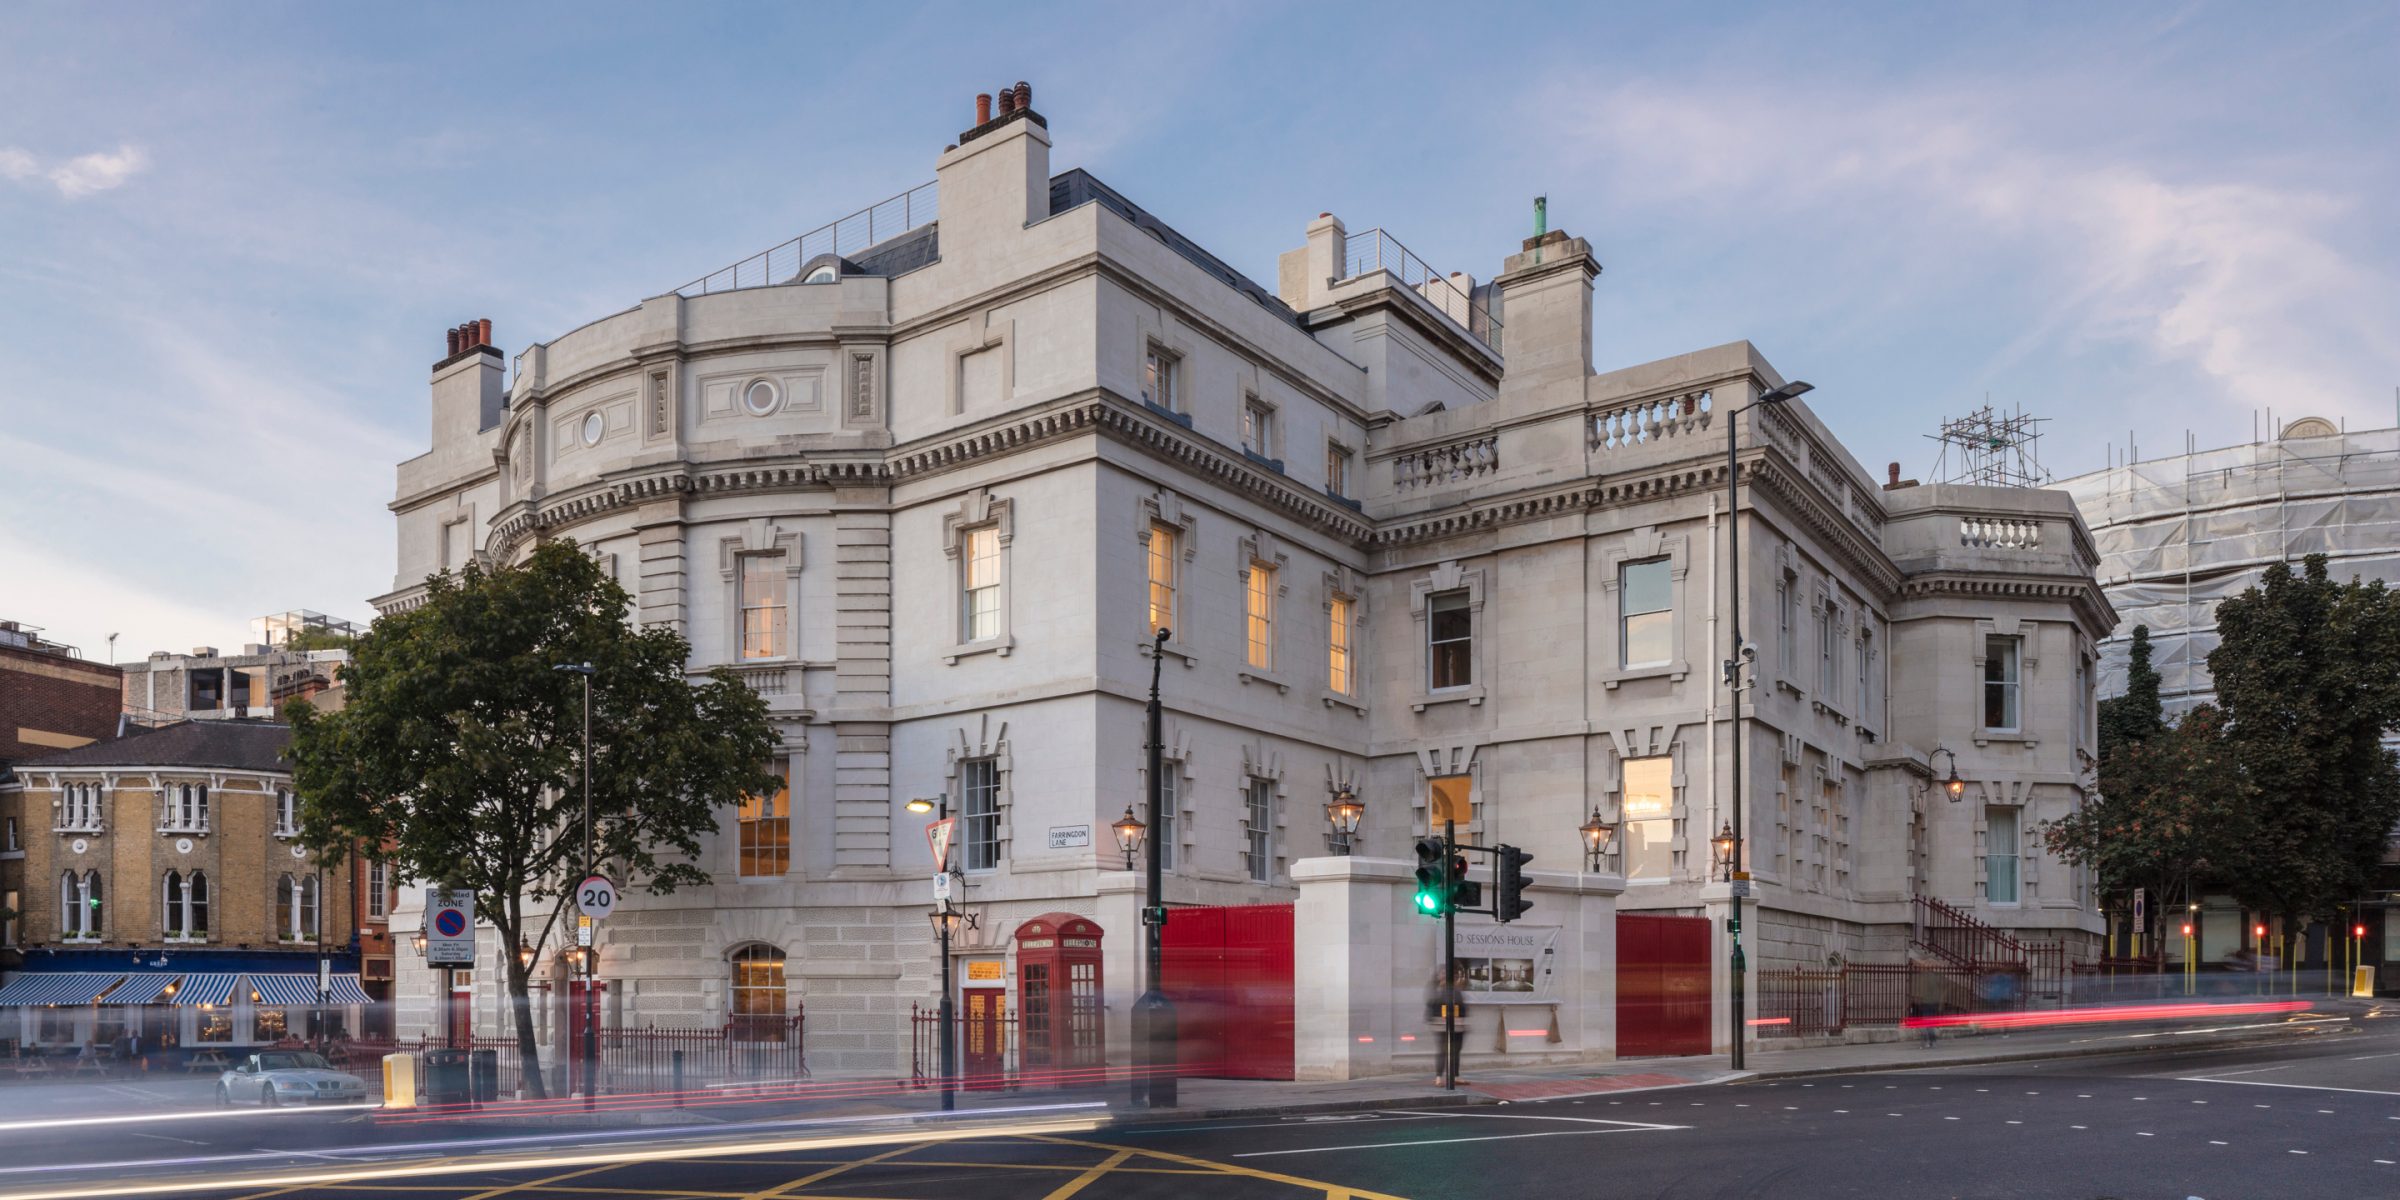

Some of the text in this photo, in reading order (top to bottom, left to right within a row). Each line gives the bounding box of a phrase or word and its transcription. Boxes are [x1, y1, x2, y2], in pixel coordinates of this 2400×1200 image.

[1052, 830, 1087, 839] FARRINGDON
[1052, 839, 1067, 847] LANE
[584, 889, 611, 907] 20
[438, 899, 464, 907] ZONE
[1466, 934, 1505, 945] SESSIONS
[1507, 936, 1535, 946] HOUSE
